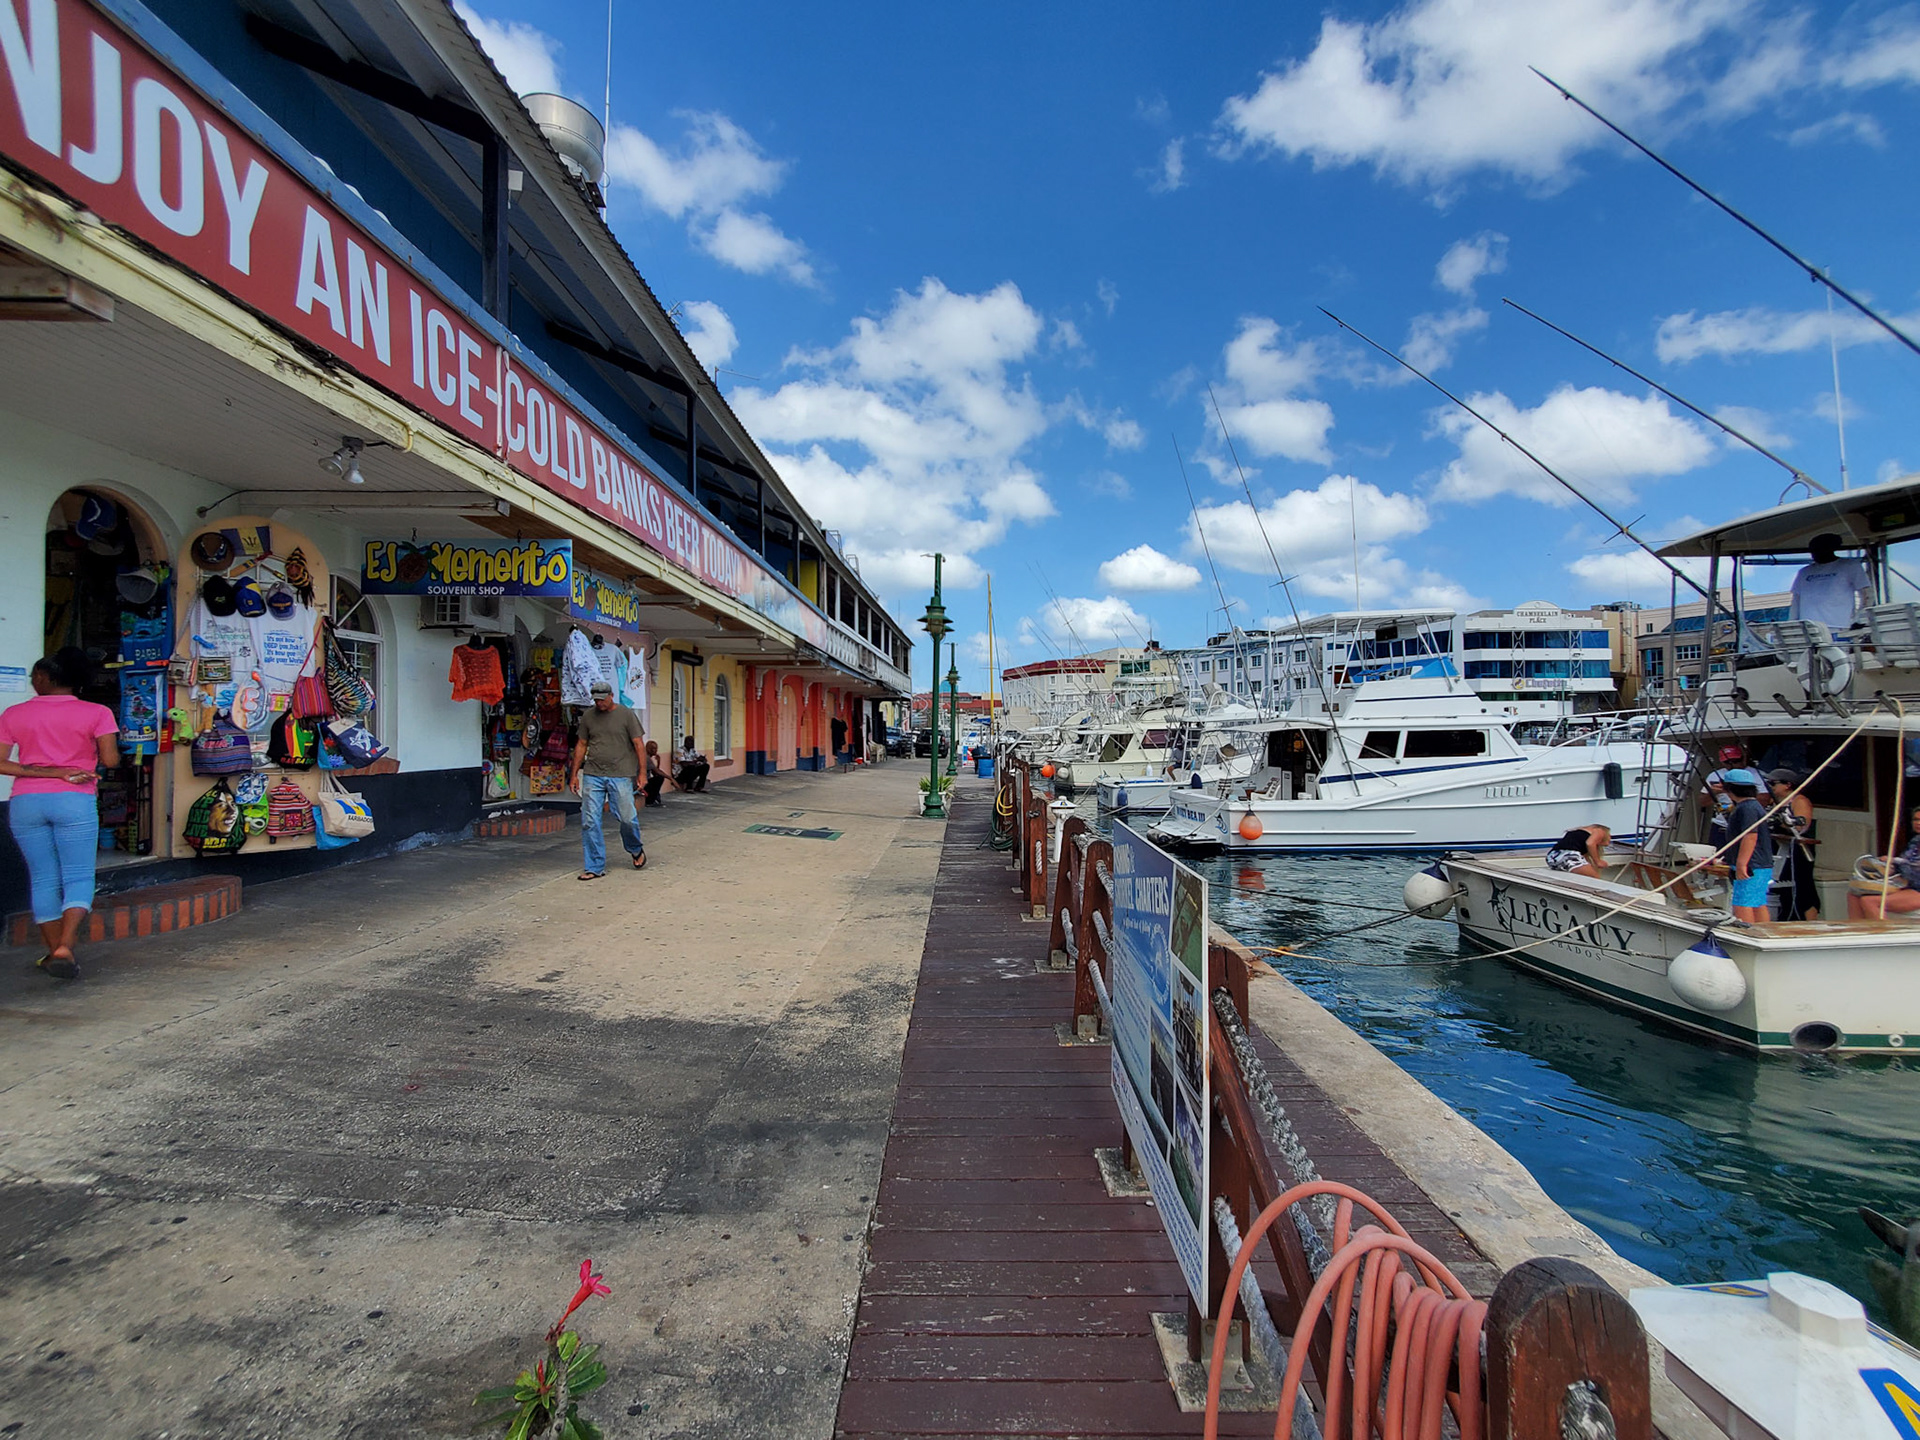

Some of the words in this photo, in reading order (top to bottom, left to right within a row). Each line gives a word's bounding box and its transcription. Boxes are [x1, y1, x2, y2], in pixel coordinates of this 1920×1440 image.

[295, 205, 392, 368] AN
[590, 435, 663, 542] BANKS
[663, 495, 700, 569] BEER
[702, 526, 741, 594] TODAY!
[366, 541, 397, 582] EJ
[431, 541, 568, 587] Memento
[427, 585, 477, 595] SOUVENIR
[478, 586, 505, 595] SHOP
[572, 570, 585, 608] EJ
[596, 579, 638, 624] Memento
[1135, 876, 1170, 916] CHARTERS
[1507, 895, 1636, 952] LEGACY
